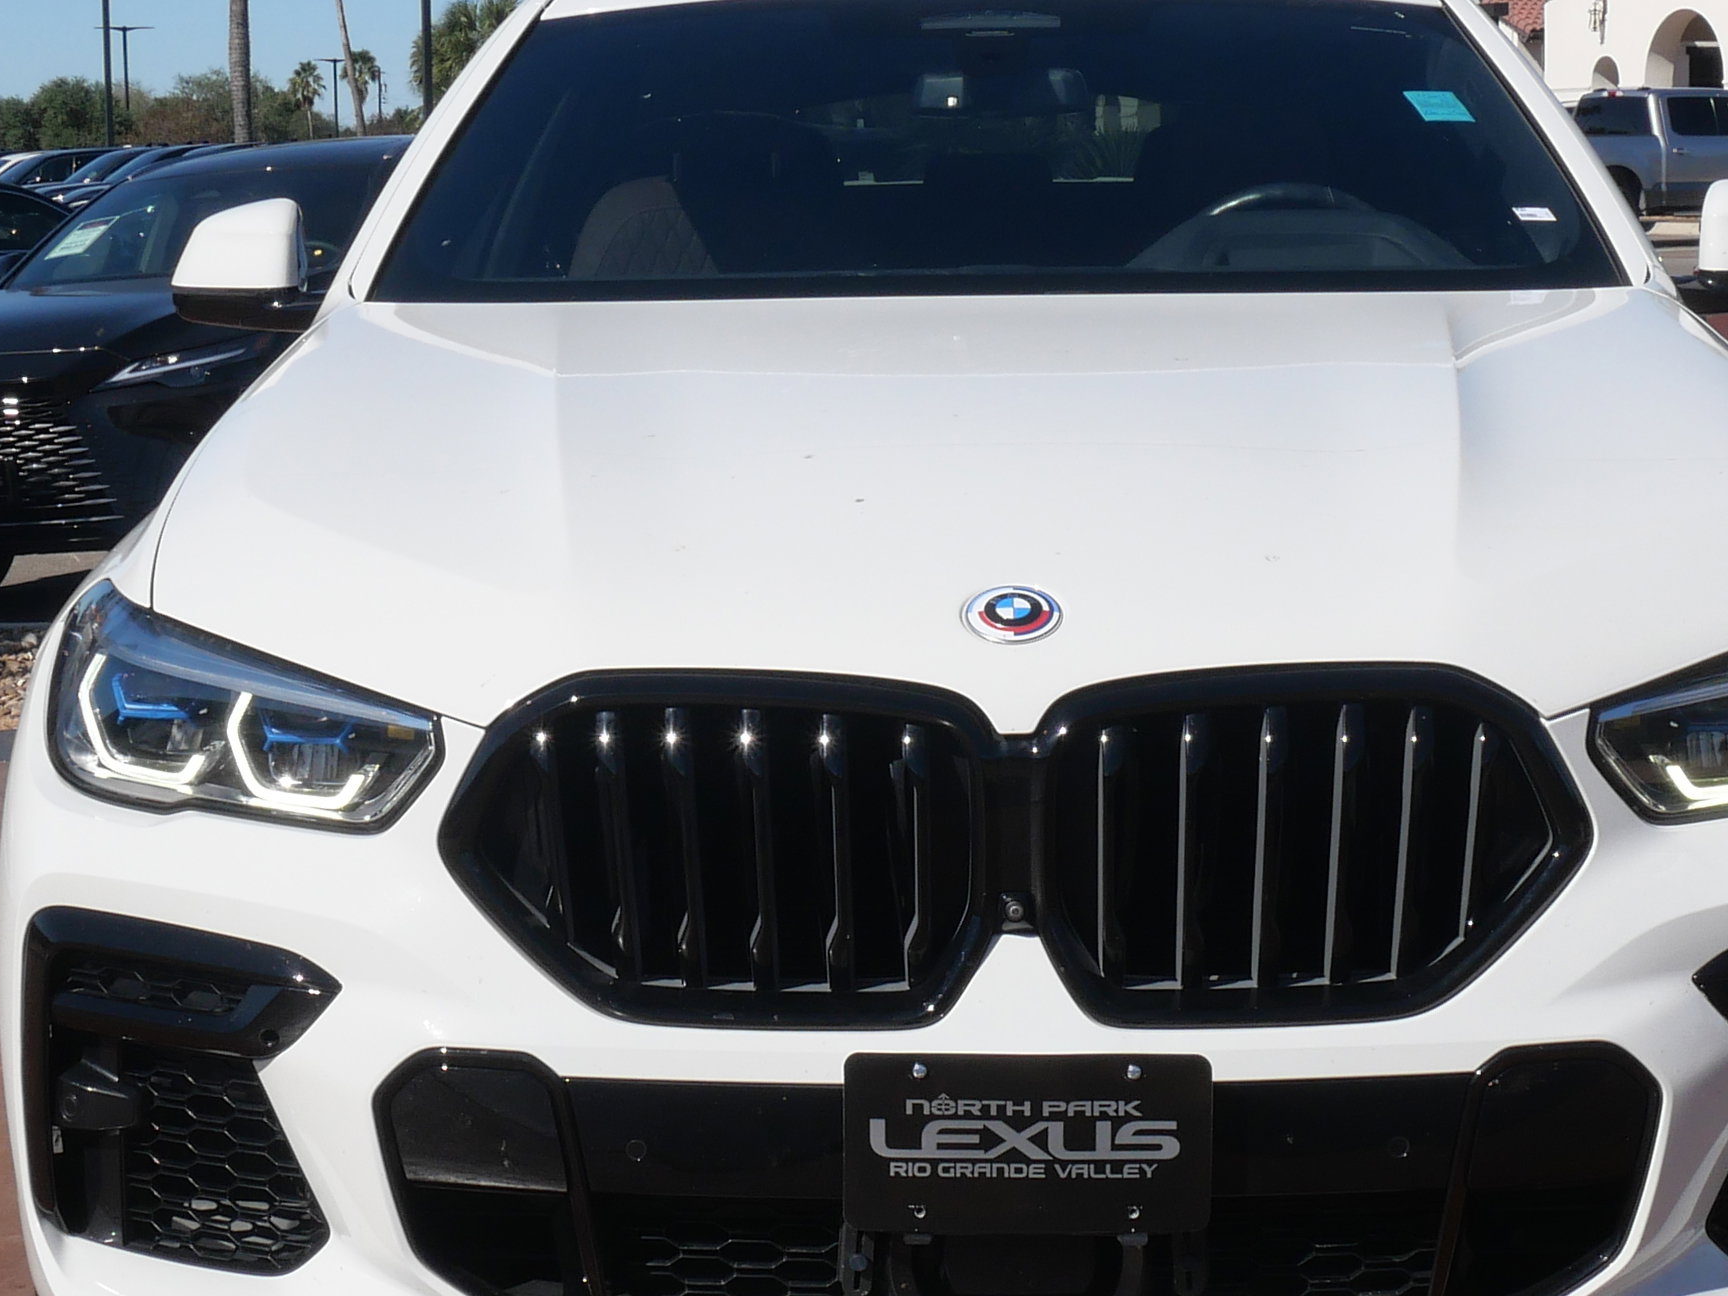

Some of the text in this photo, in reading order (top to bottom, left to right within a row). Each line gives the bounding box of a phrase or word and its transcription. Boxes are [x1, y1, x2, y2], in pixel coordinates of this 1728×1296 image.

[906, 1093, 1143, 1117] NORTH PARK
[869, 1117, 1181, 1161] LEXUS
[889, 1162, 1158, 1179] RIO GRANDE VALLEY
